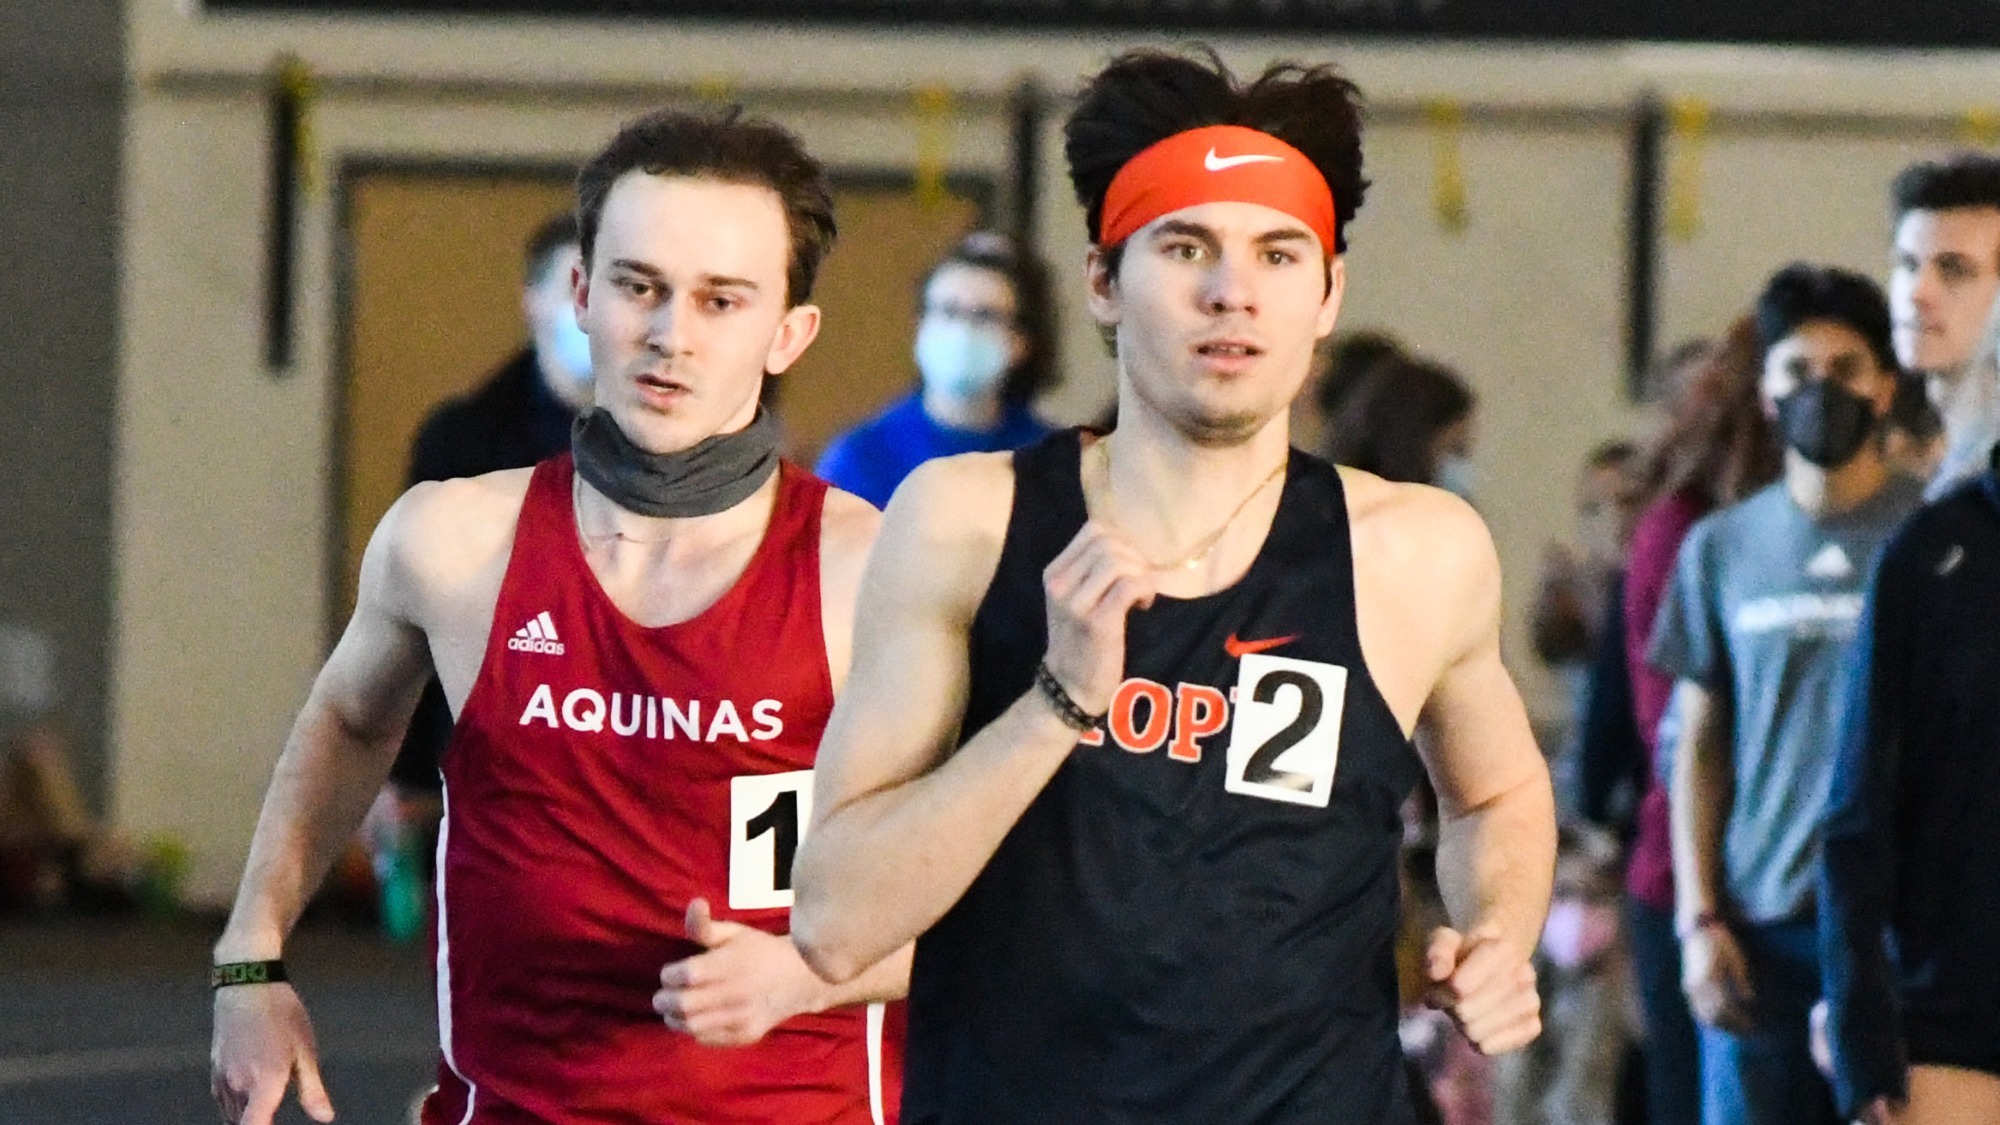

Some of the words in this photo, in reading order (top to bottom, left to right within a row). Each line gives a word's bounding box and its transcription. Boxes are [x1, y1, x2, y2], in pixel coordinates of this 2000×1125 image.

[508, 636, 565, 656] adidas
[519, 684, 784, 743] AQUINAS
[1079, 677, 1239, 763] OP
[1242, 669, 1324, 793] 2
[746, 790, 798, 890] 1
